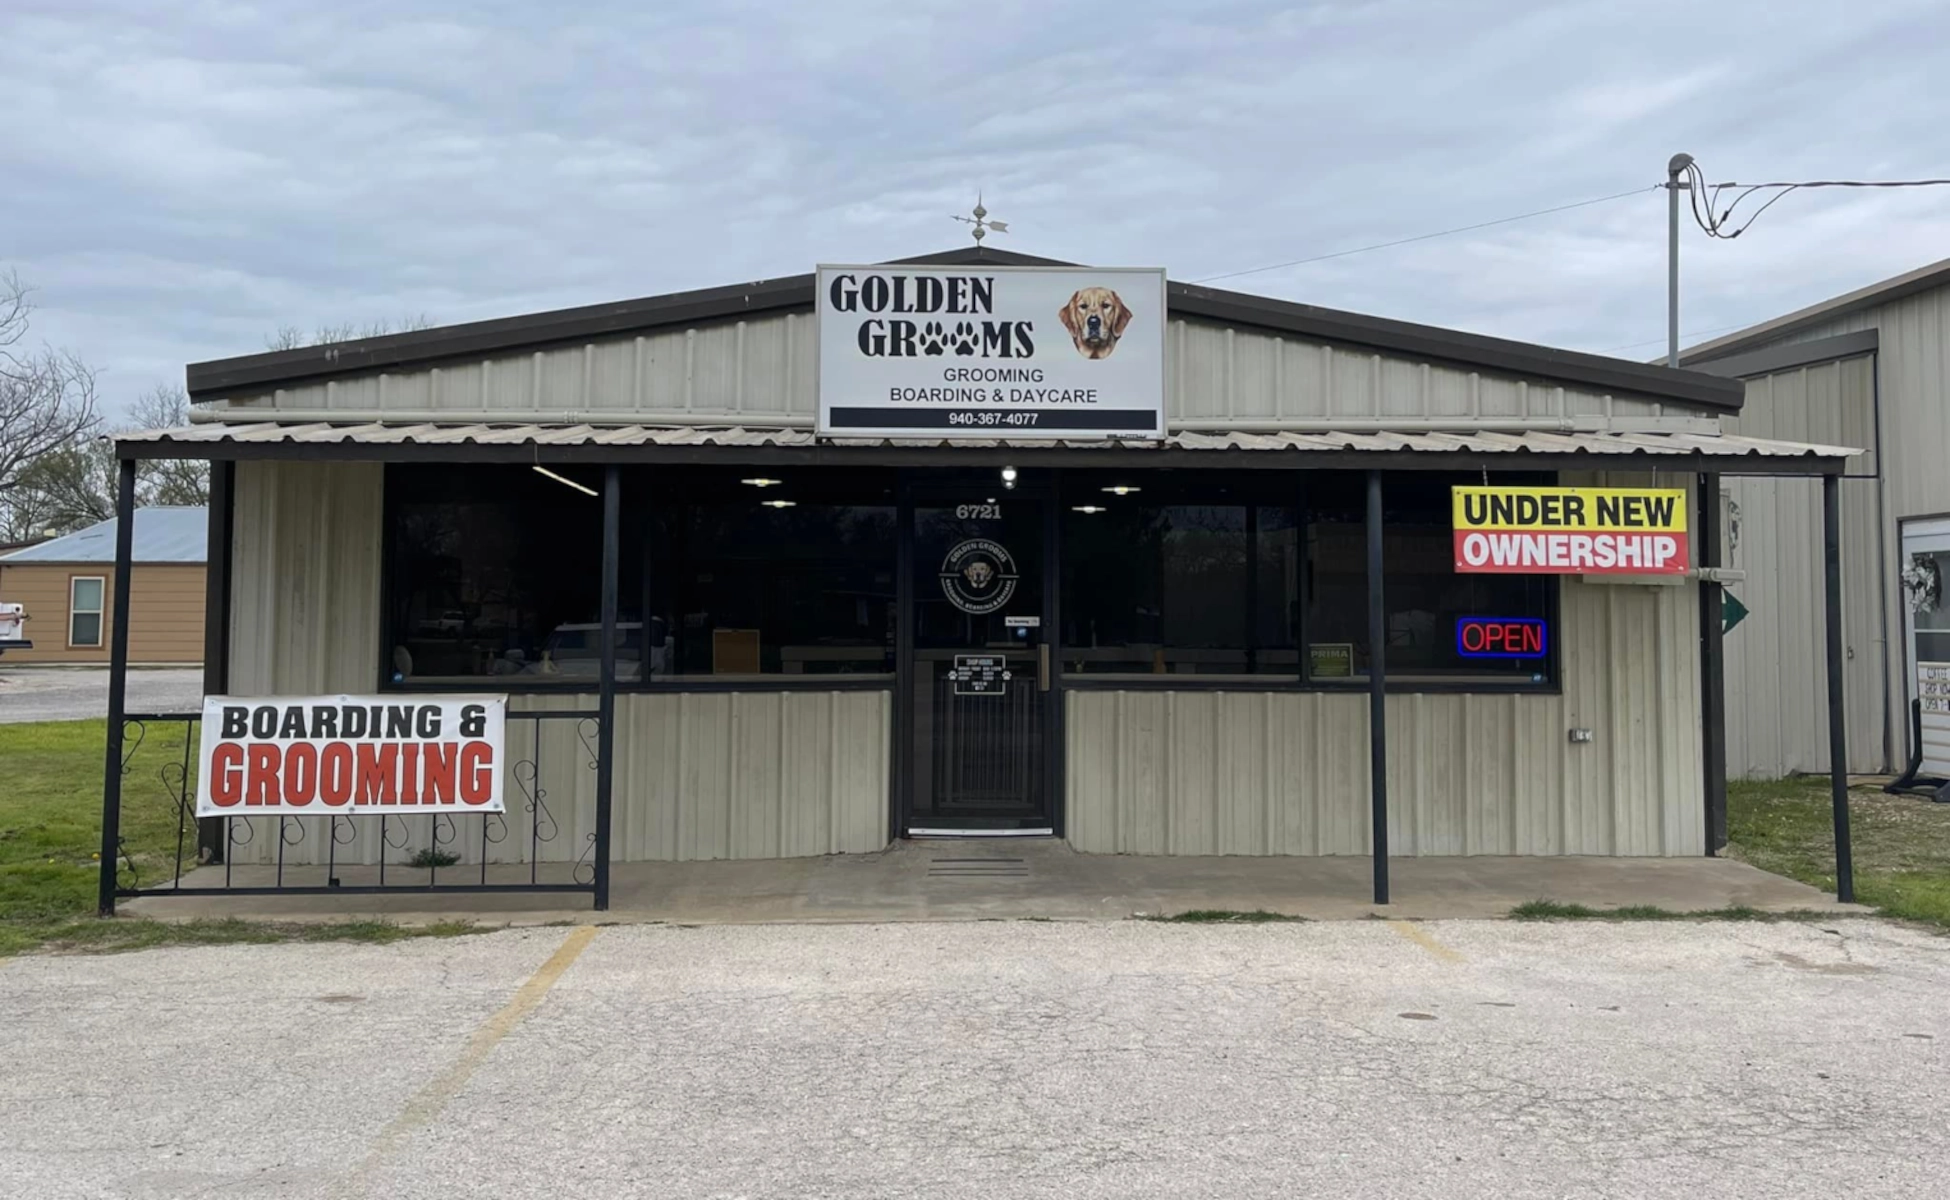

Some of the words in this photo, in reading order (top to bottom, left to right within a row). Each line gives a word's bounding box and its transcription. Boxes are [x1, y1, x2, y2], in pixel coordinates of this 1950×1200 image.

[830, 275, 994, 314] GOLDEN
[943, 368, 1044, 382] GROOMING
[890, 387, 986, 402] BOARDING
[992, 389, 1004, 402] &
[1010, 389, 1098, 404] DAYCARE
[949, 412, 1038, 426] 940-367-4077
[956, 504, 1002, 520] 6721
[1463, 493, 1586, 526] UNDER
[1597, 496, 1676, 527] NEW
[950, 542, 977, 563] GOLDEN
[1463, 532, 1678, 567] OWNERSHIP
[1462, 623, 1541, 651] OPEN
[1310, 650, 1348, 659] PRIMA
[221, 705, 442, 739] BOARDING
[459, 704, 486, 738] &
[210, 740, 493, 807] GROOMING
